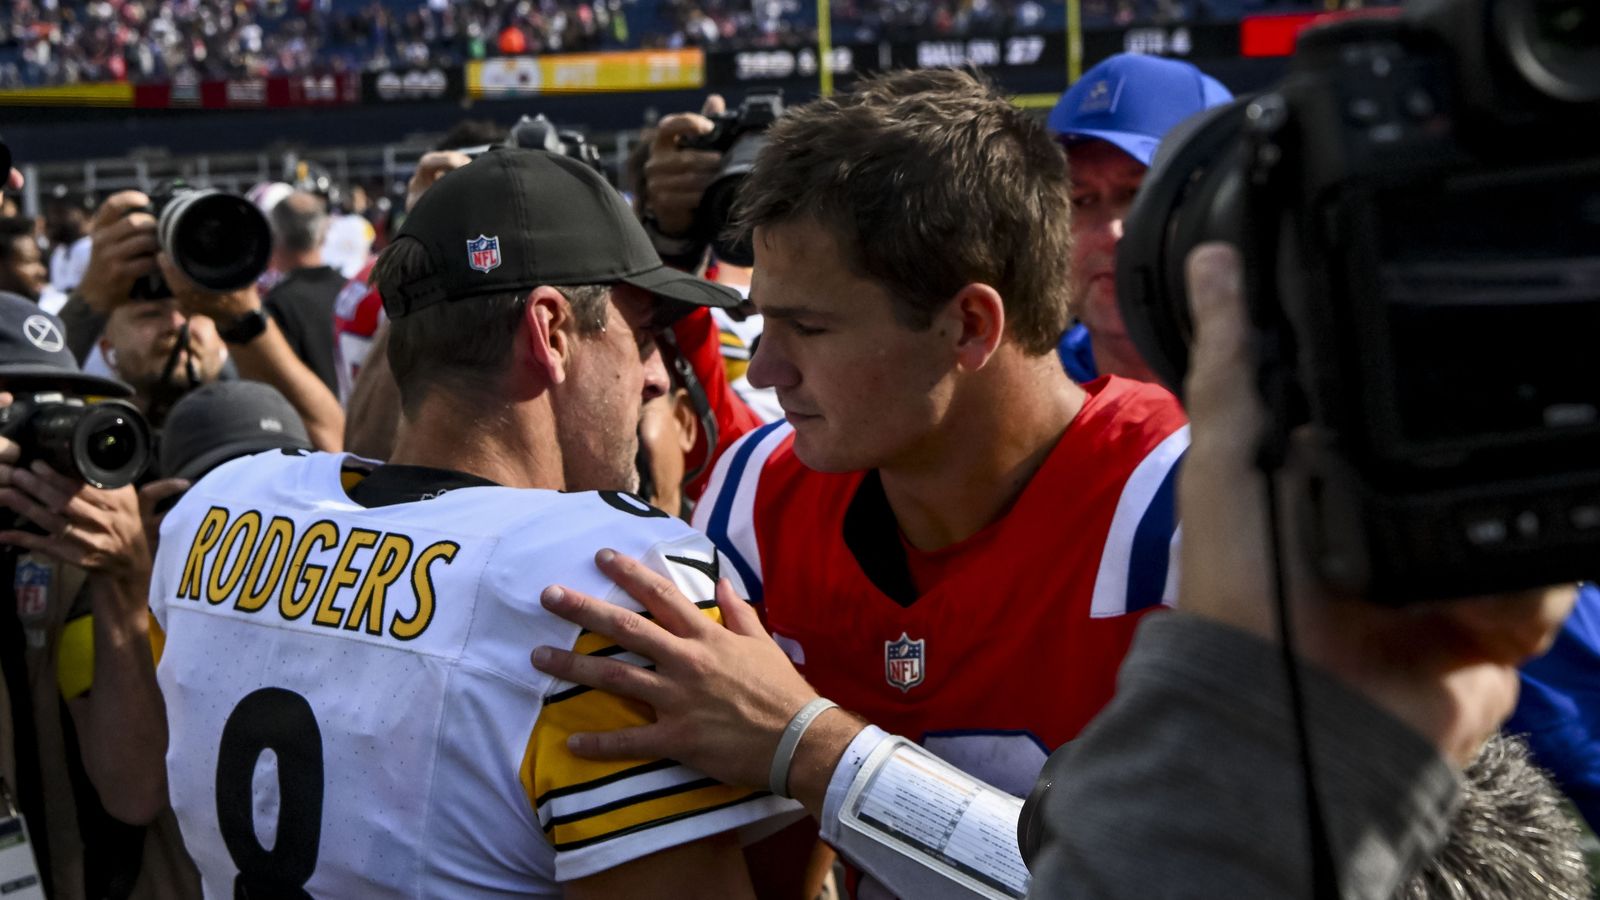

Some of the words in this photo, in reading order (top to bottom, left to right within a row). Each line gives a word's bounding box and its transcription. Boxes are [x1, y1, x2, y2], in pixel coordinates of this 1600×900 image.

[473, 250, 497, 267] NFL
[177, 506, 461, 641] RODGERS
[890, 660, 919, 682] NFL
[216, 687, 325, 900] 8
